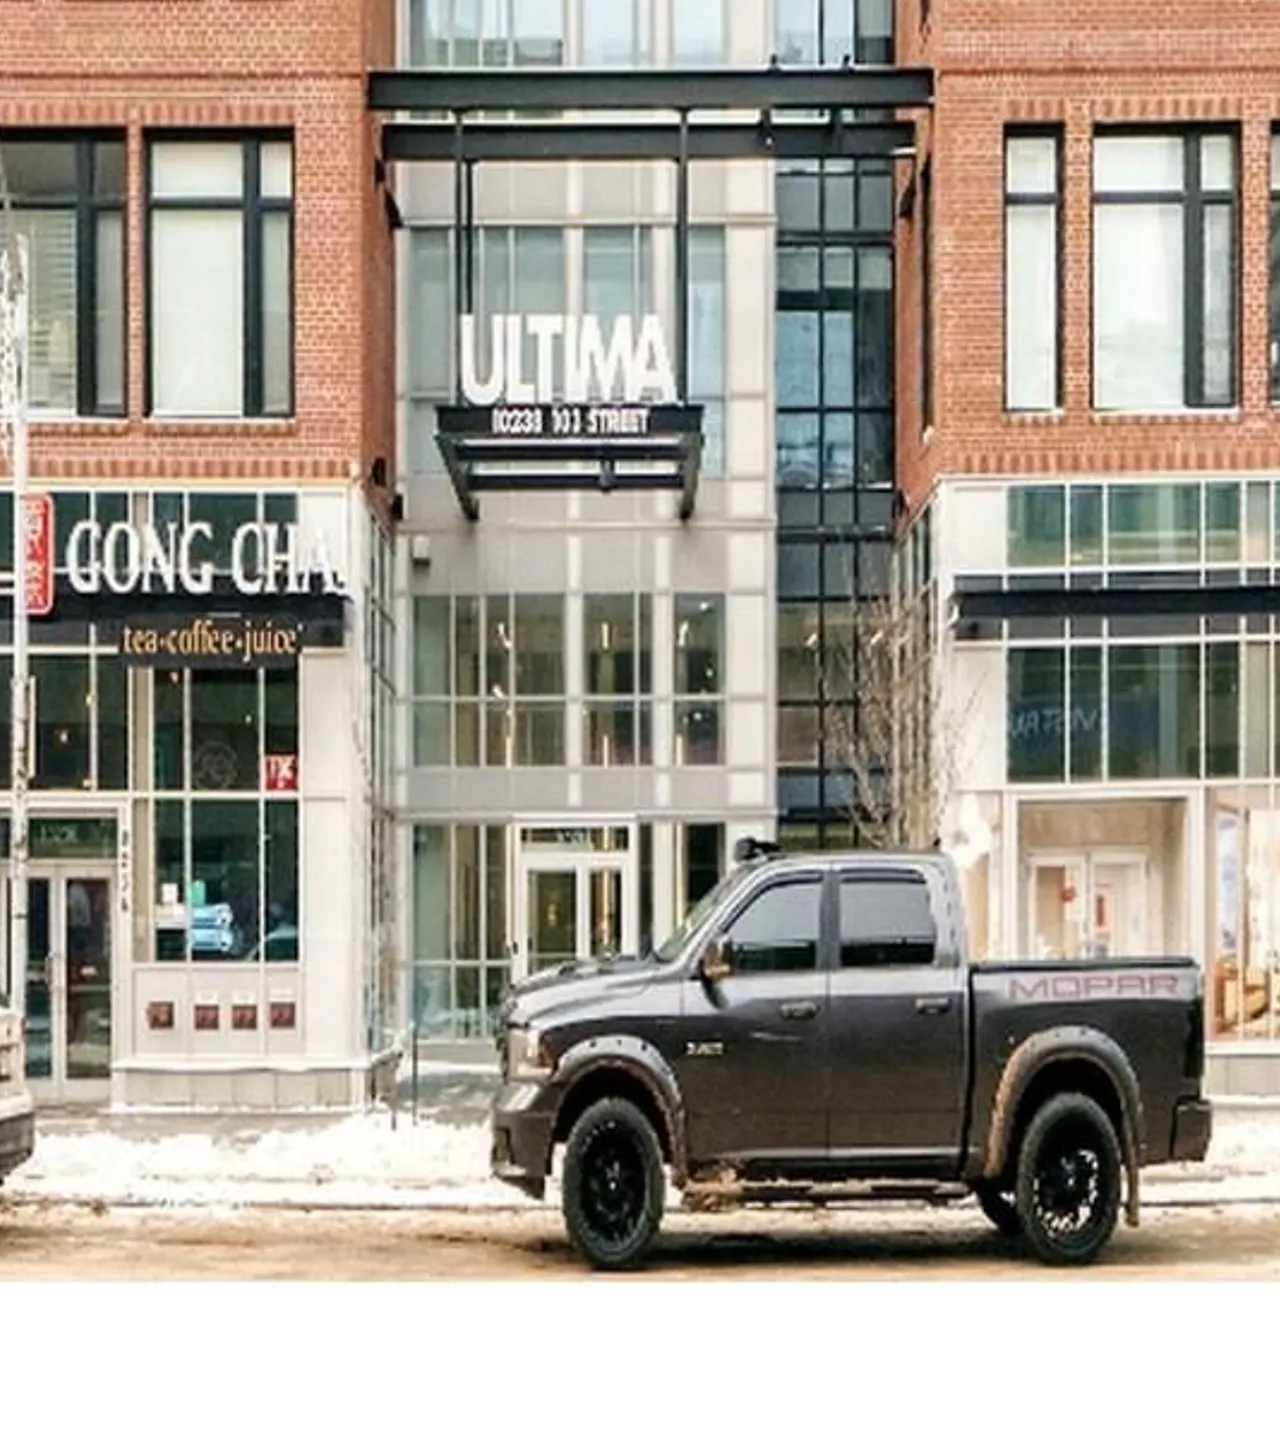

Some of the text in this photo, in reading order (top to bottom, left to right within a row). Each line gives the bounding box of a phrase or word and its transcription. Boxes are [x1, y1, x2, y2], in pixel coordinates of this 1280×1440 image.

[460, 314, 678, 405] ULTIMA
[588, 408, 649, 433] STREET
[65, 521, 214, 595] GONG
[231, 522, 349, 597] CHA
[1009, 973, 1179, 1001] MOPAR
